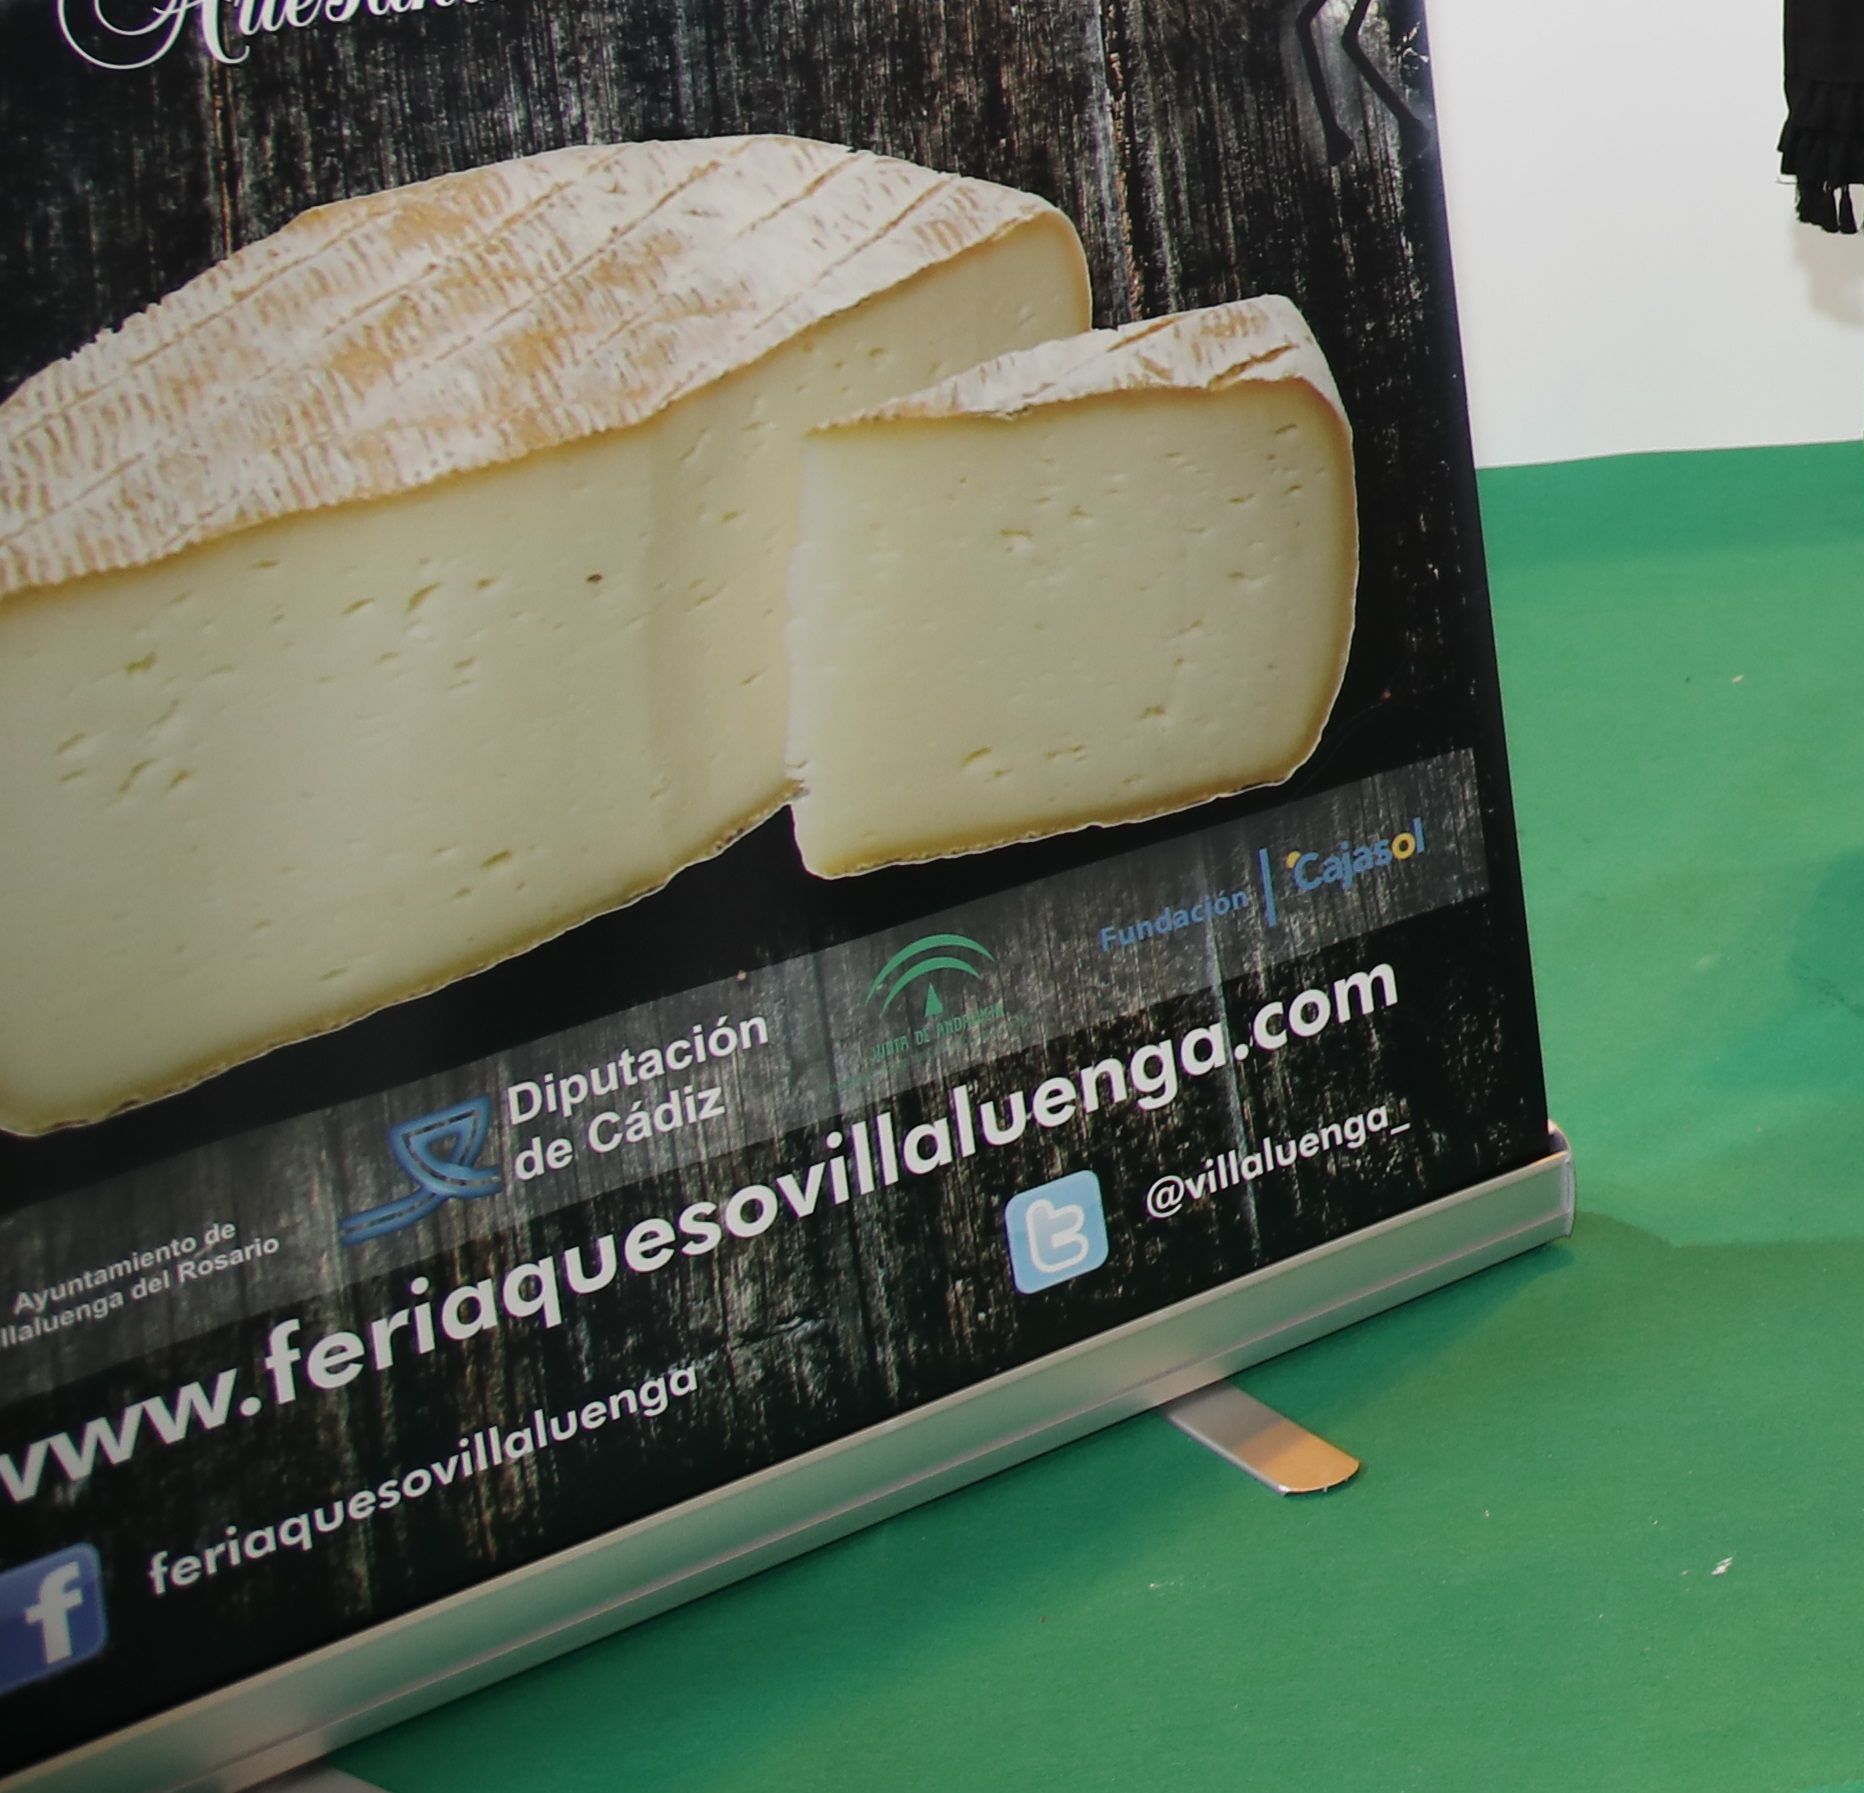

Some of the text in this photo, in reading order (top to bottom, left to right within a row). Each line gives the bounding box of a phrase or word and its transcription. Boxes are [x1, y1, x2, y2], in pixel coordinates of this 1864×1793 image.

[1100, 816, 1426, 954] Fundación Cajasol
[506, 1012, 770, 1126] Diputación
[514, 1082, 728, 1183] de Cádiz
[13, 1221, 237, 1316] Ayuntamiento de
[130, 1269, 170, 1301] del
[177, 1235, 281, 1284] Rosario
[149, 1365, 700, 1597] feriaquesovillaluenga
